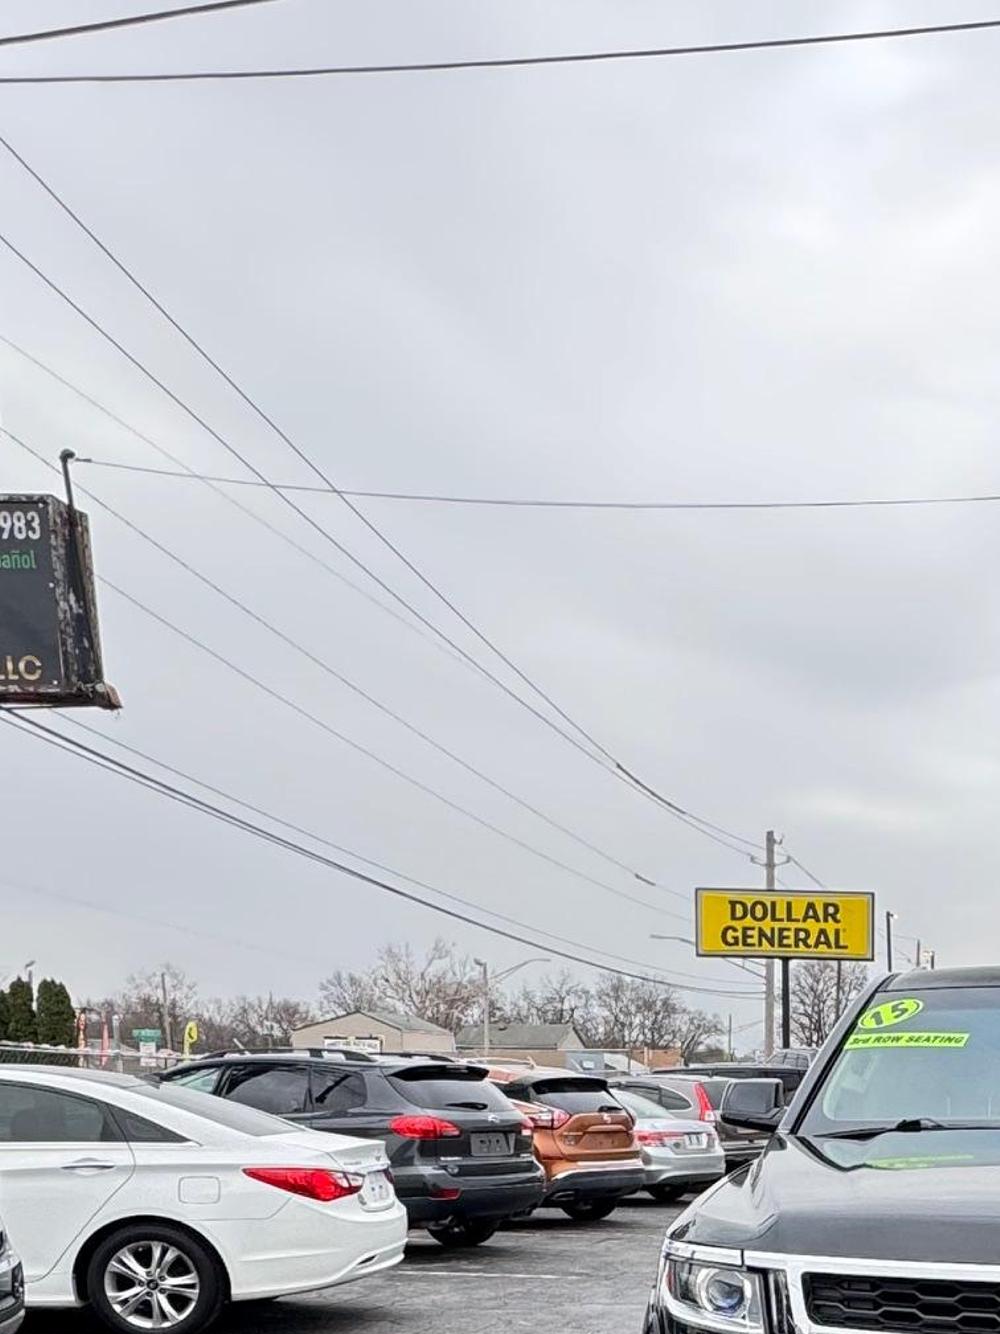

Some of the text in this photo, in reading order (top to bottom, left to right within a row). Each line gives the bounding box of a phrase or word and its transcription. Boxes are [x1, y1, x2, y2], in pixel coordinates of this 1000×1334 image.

[0, 511, 41, 540] 983
[0, 550, 37, 569] añol
[728, 900, 841, 924] DOLLAR
[720, 925, 849, 949] GENERAL
[869, 1002, 909, 1026] 15
[872, 1035, 903, 1044] ROW
[905, 1035, 965, 1044] SEATING
